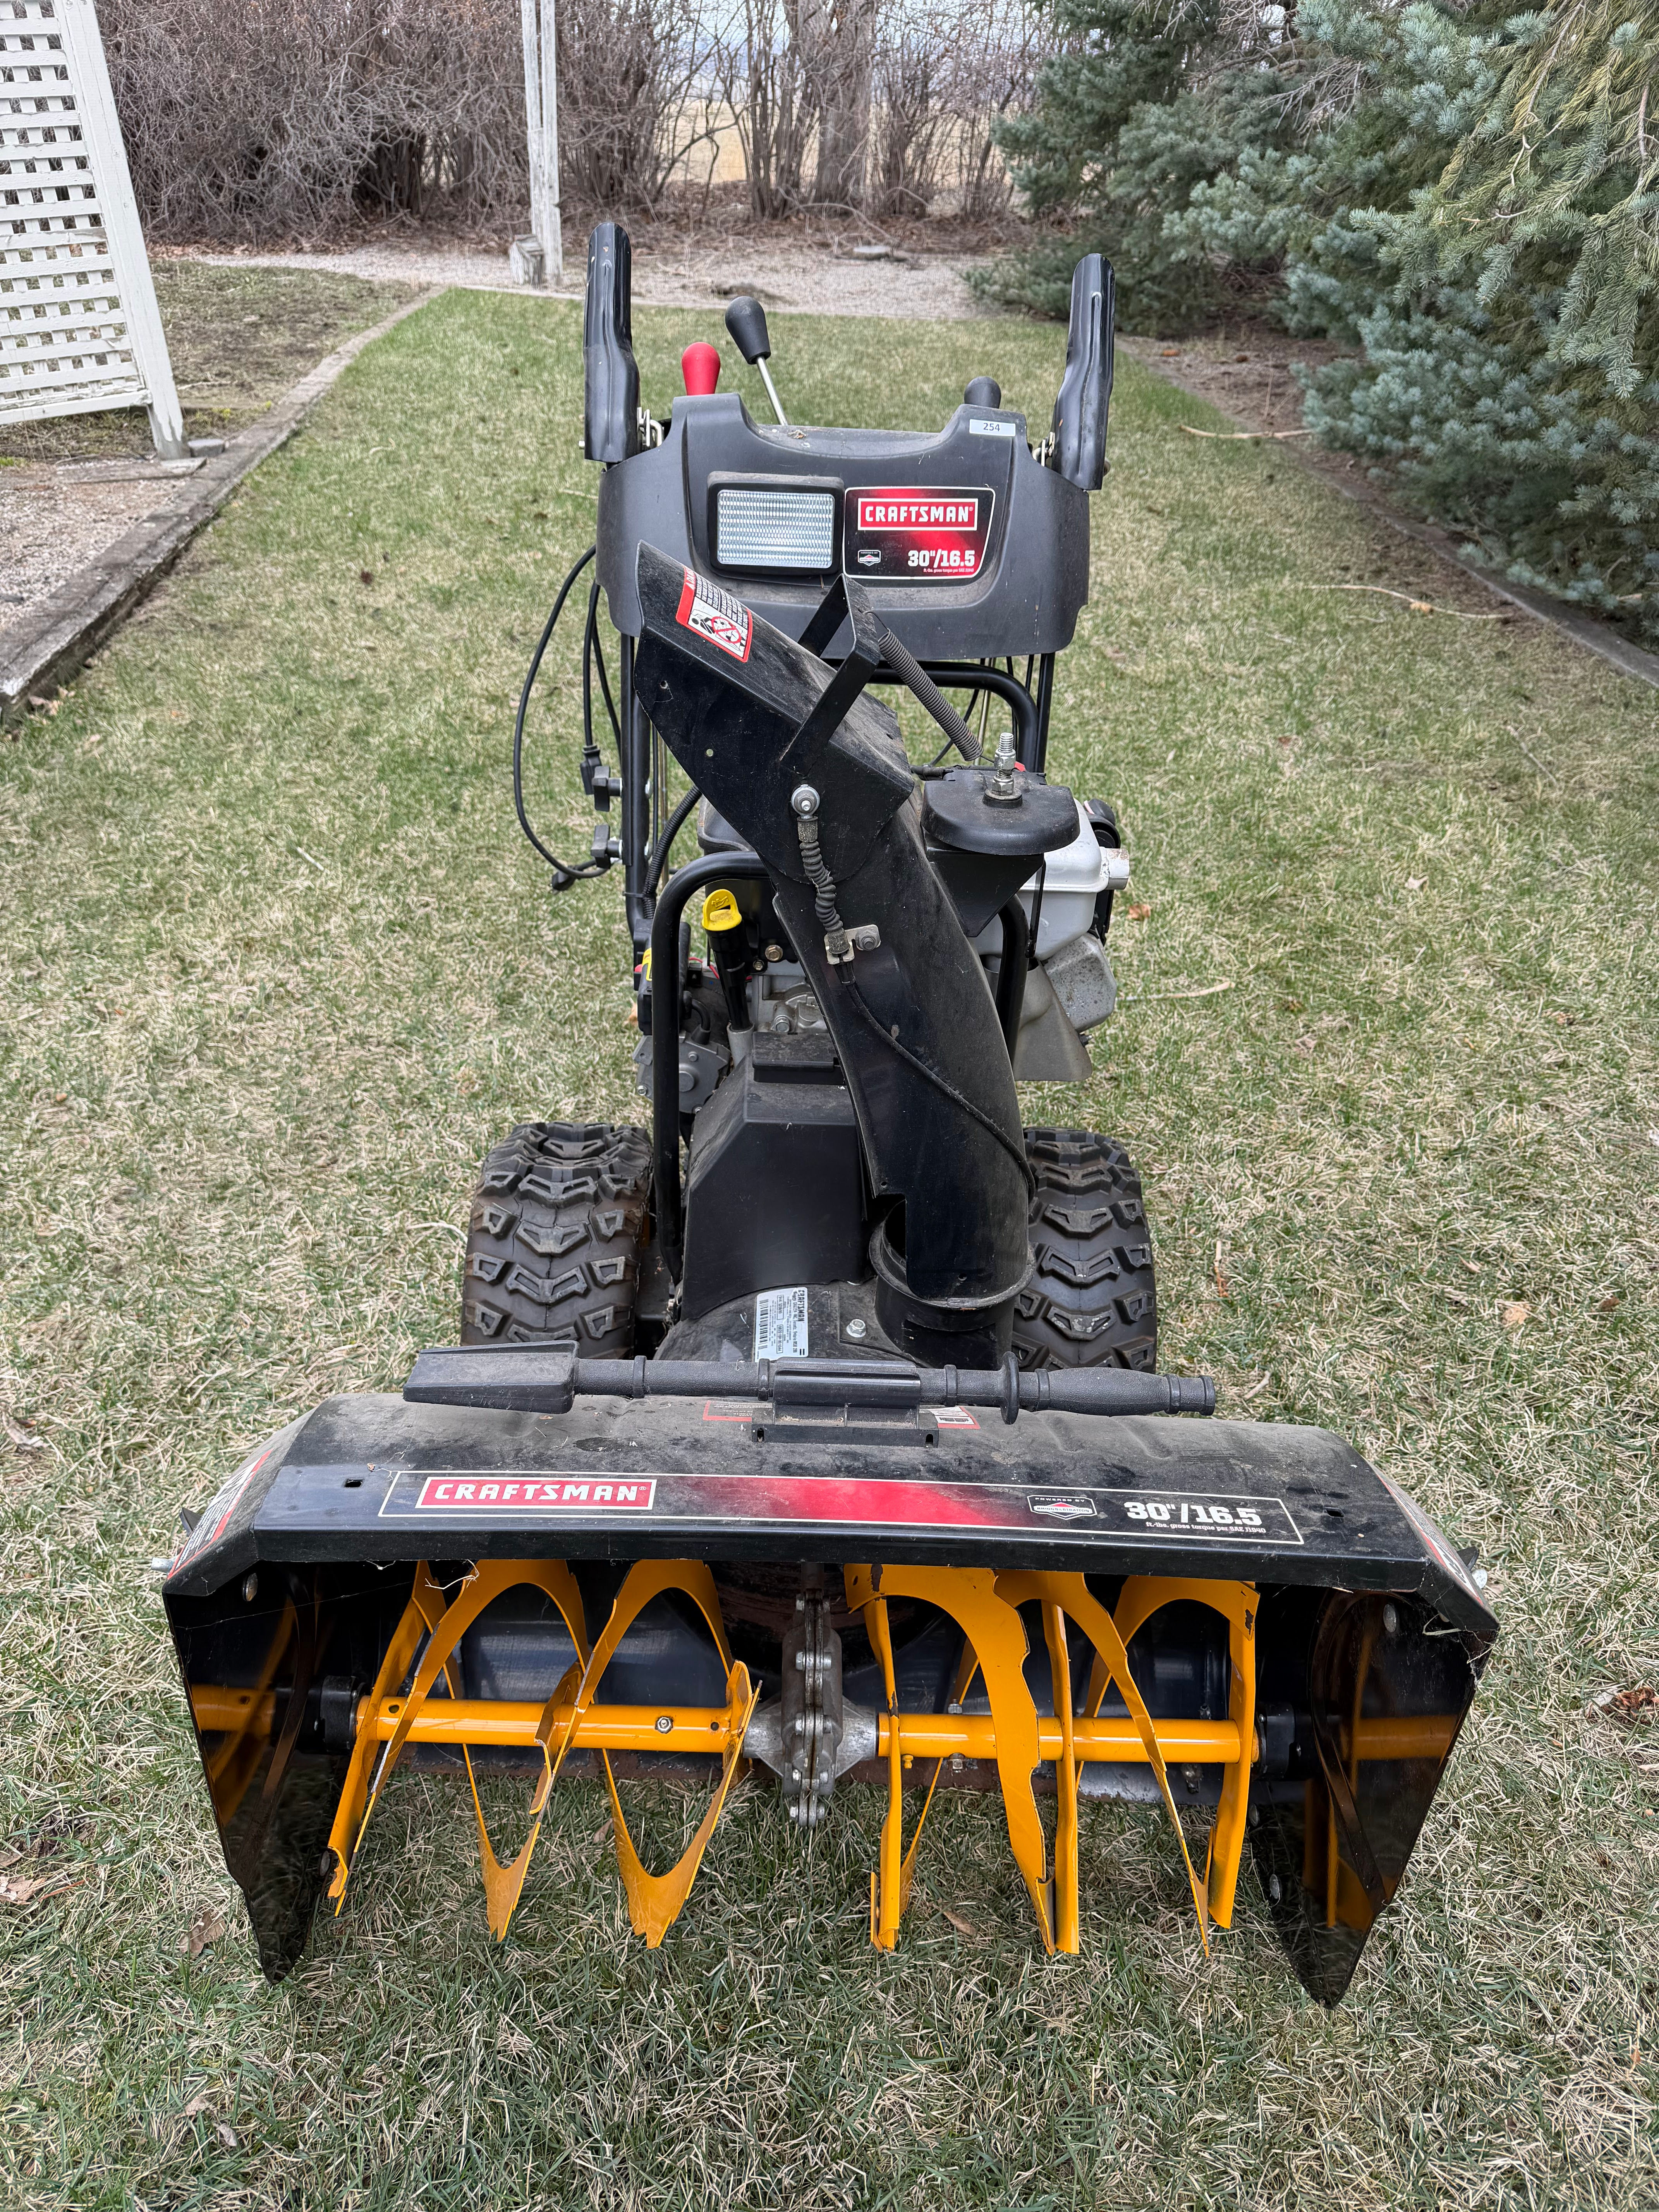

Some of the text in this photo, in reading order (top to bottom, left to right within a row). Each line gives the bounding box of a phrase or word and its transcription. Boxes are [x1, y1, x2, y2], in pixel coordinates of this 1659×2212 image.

[983, 422, 1000, 432] 254
[865, 505, 970, 522] CRAFTSMAN
[908, 549, 975, 567] 30"/16.5
[434, 1484, 638, 1501] CRAFTSMAN
[1124, 1501, 1262, 1526] 30"/16.5
